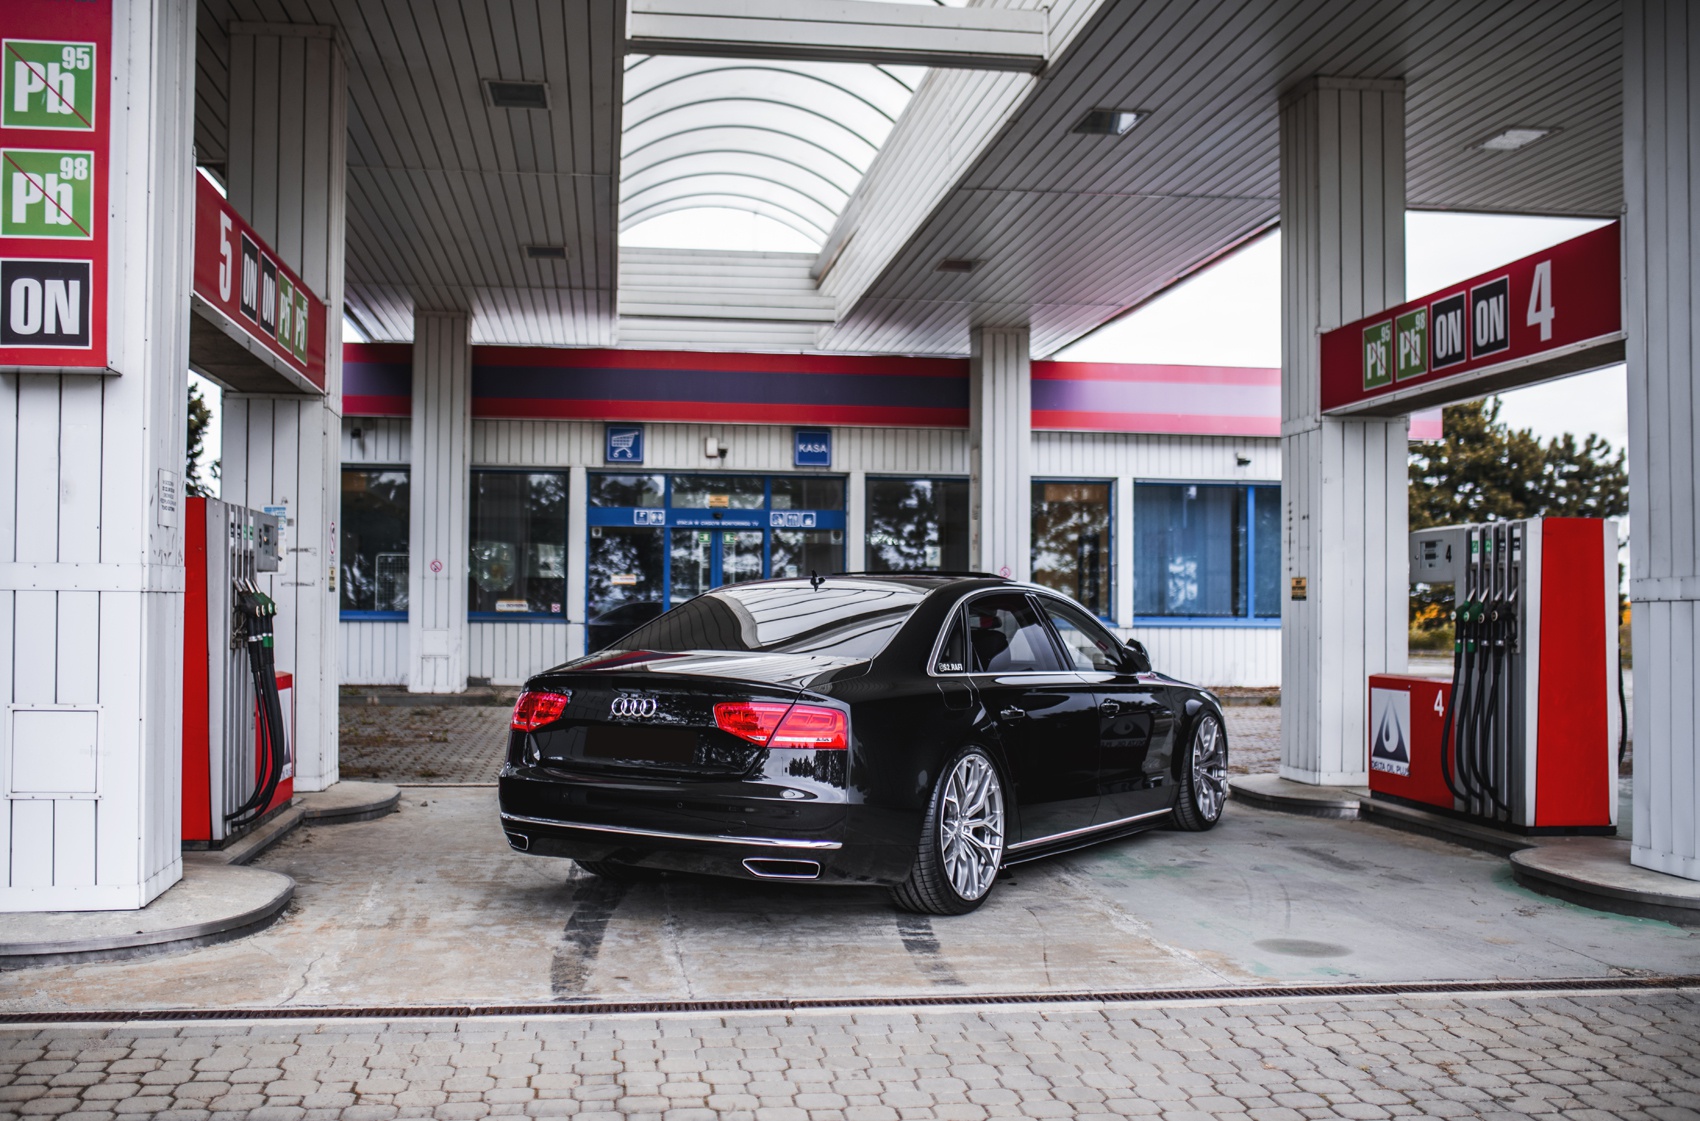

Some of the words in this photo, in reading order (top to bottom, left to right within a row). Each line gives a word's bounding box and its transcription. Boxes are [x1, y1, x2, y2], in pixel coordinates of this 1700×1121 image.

[14, 60, 75, 115] Pb
[62, 46, 90, 70] 95
[12, 172, 73, 225] Pb
[60, 157, 88, 180] 98
[219, 209, 232, 303] 5
[242, 253, 258, 311] ON
[262, 271, 276, 326] ON
[10, 278, 80, 335] ON
[1367, 340, 1386, 379] Pb
[1381, 325, 1390, 343] 95
[1400, 328, 1420, 370] Pb
[1415, 312, 1426, 331] 98
[1435, 308, 1461, 359] ON
[1475, 293, 1504, 347] ON
[1526, 259, 1555, 341] 4
[799, 443, 827, 453] KASA
[1445, 544, 1452, 563] 4
[1433, 689, 1444, 717] 4
